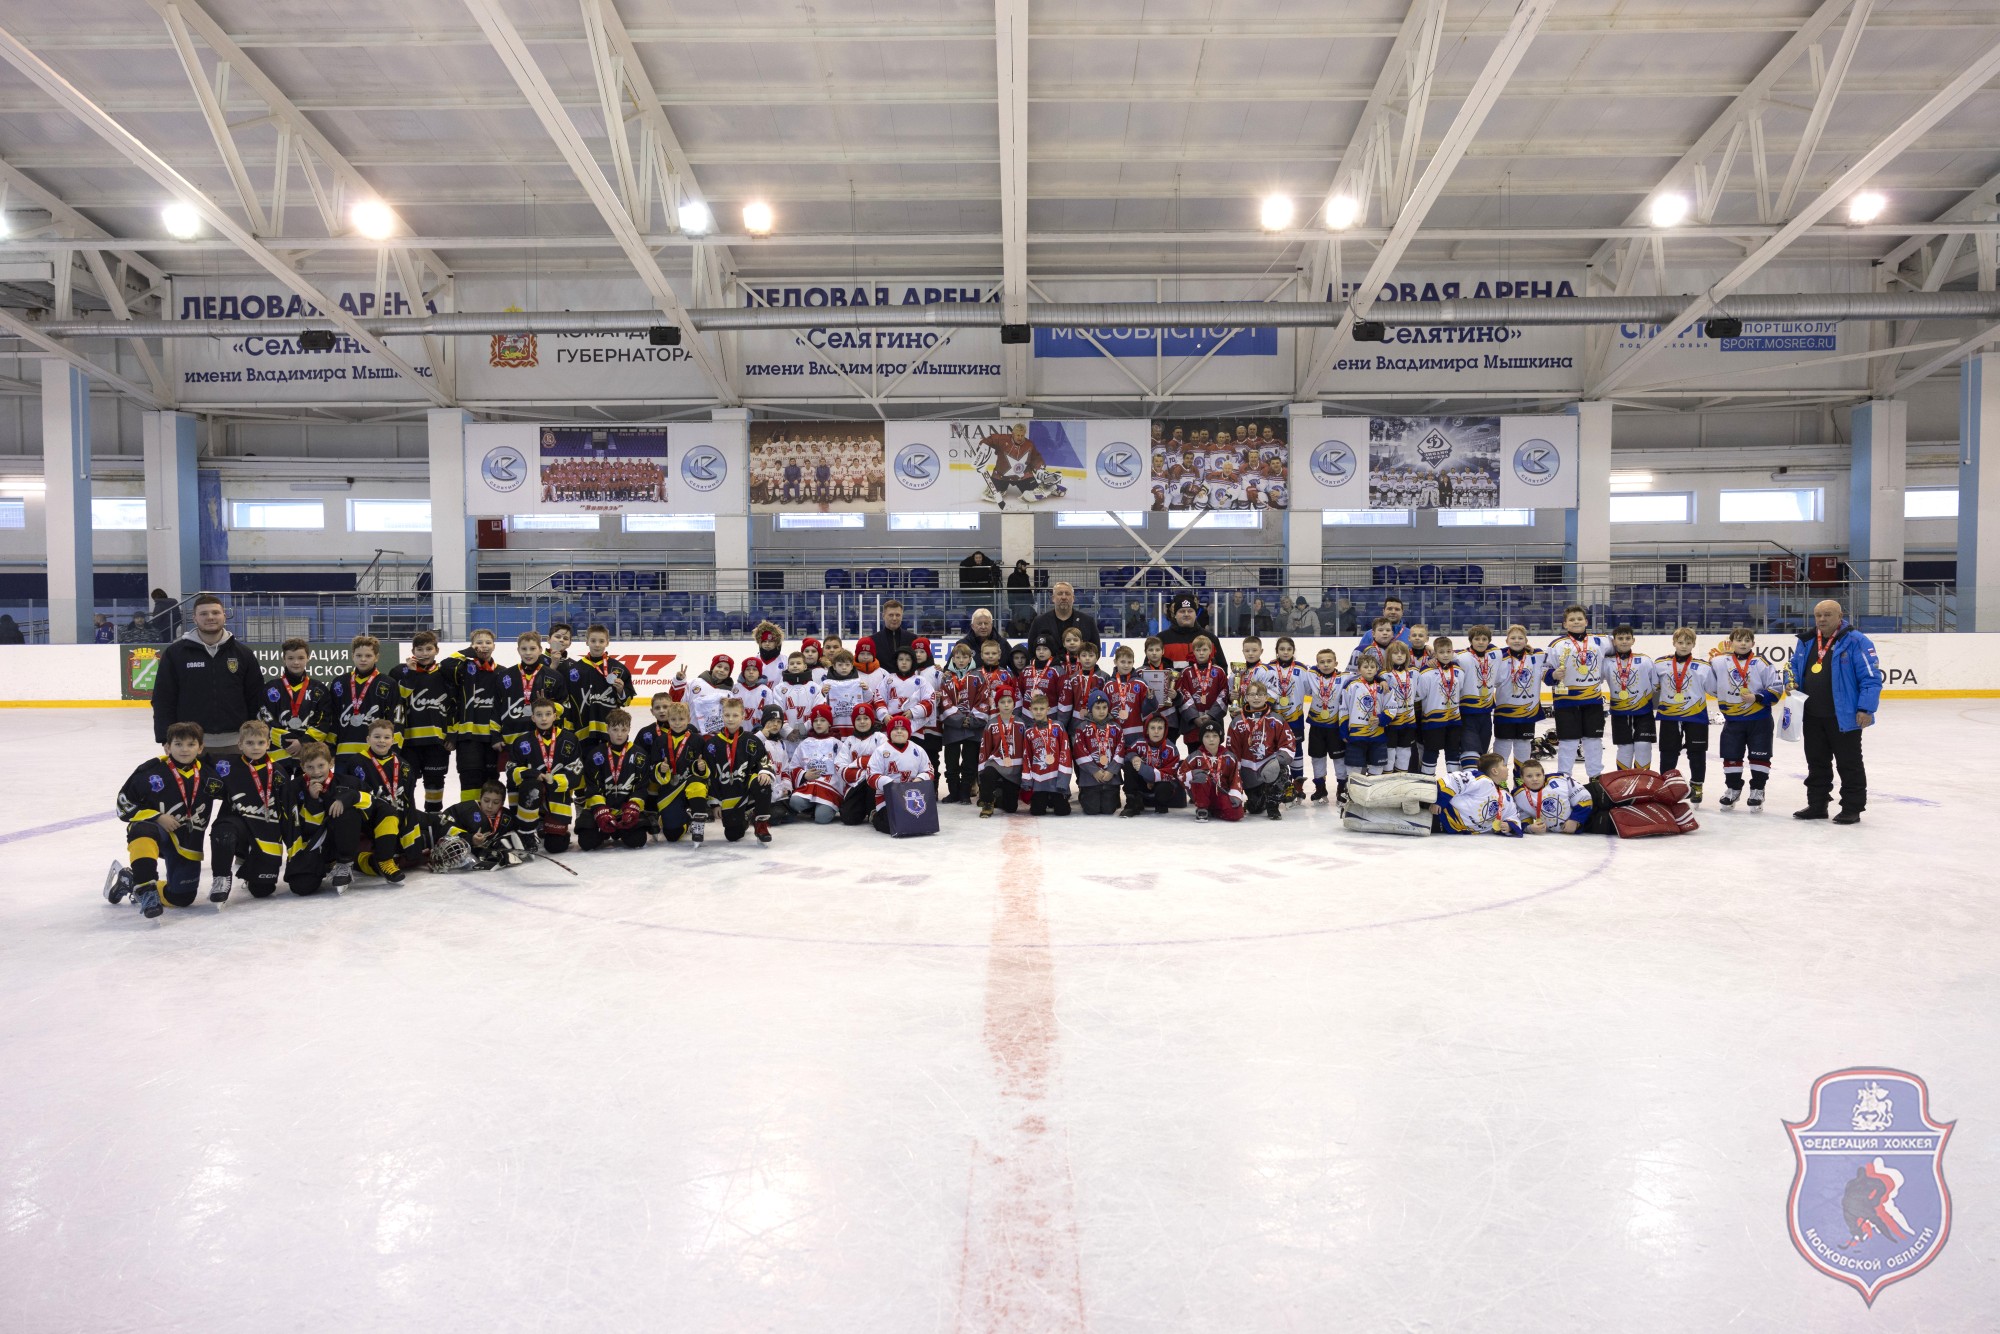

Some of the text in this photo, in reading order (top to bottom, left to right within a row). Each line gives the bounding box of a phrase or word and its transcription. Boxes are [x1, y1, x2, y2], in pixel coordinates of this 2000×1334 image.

[1722, 337, 1834, 350] SPORT.MOSREG.RU
[745, 361, 1001, 377] имени Владимира Мышкина
[1376, 355, 1479, 372] Владимира
[1483, 354, 1573, 369] Мышкина
[184, 370, 242, 383] имени
[246, 367, 346, 384] Владимира
[186, 661, 205, 669] COACH
